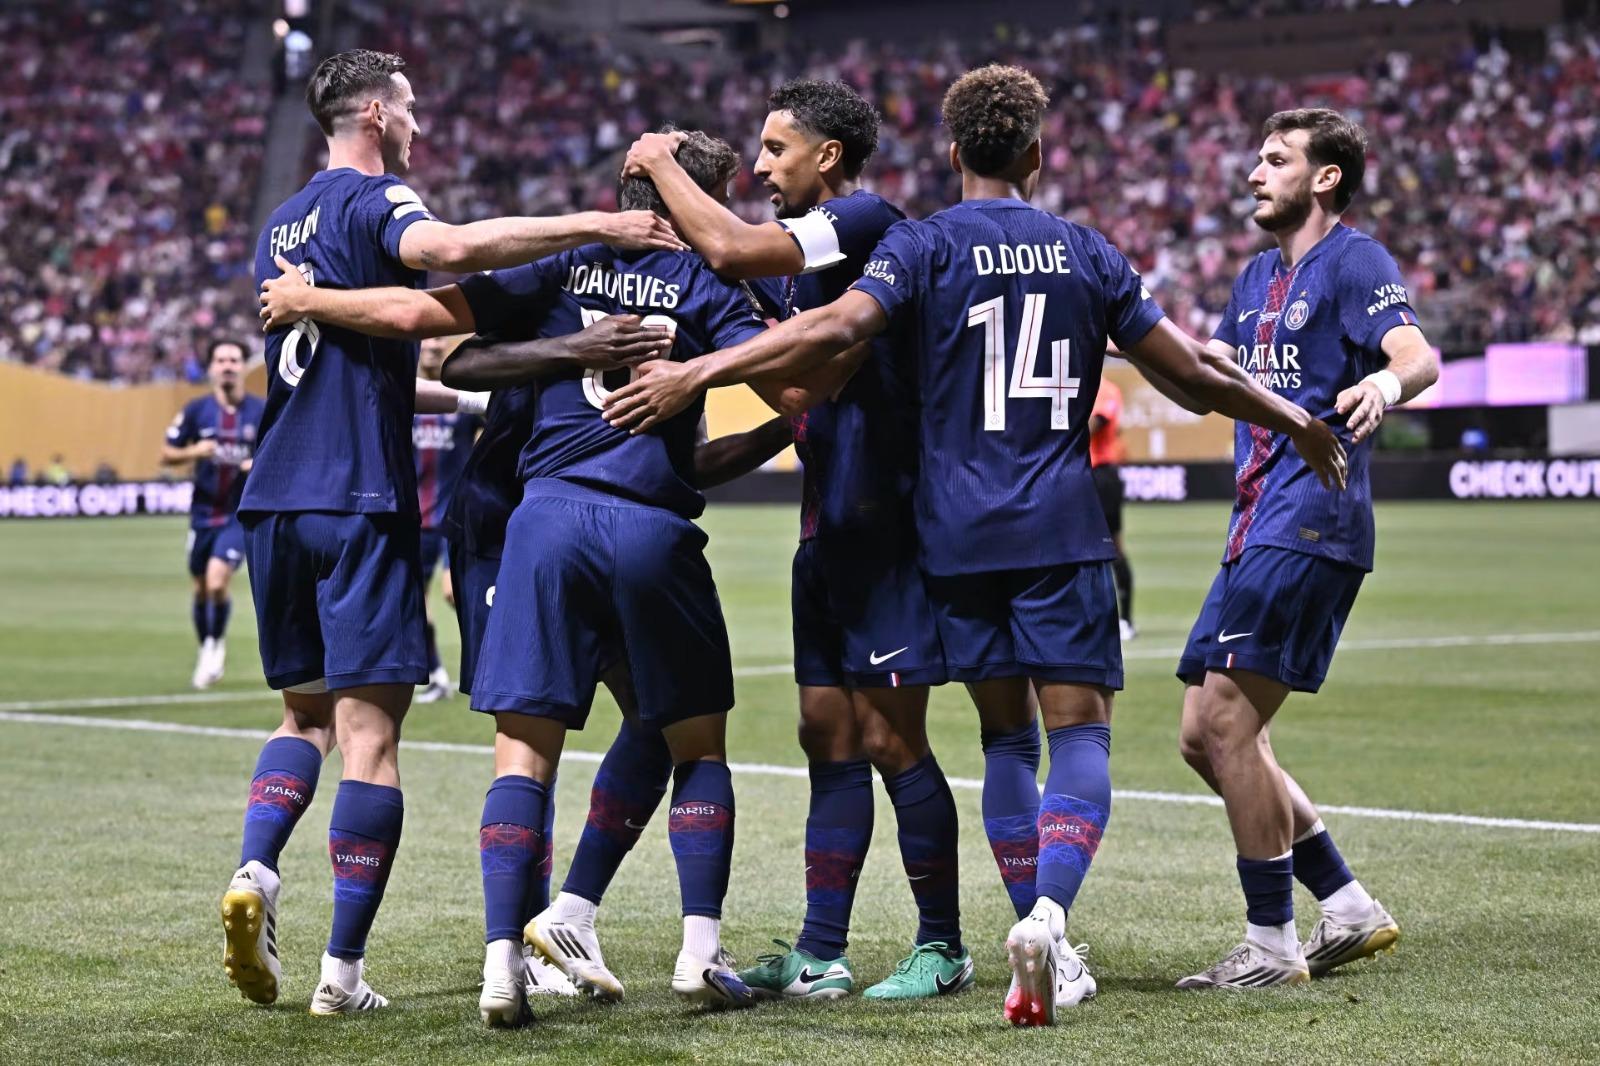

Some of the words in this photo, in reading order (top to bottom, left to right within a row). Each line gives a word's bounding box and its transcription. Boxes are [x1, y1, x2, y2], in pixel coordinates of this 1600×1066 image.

[973, 240, 1071, 276] D.DOUÉ
[967, 293, 1081, 431] 14
[1237, 344, 1302, 370] QATAR
[1450, 460, 1547, 498] CHECK
[79, 483, 140, 515] OUT
[264, 785, 305, 805] PARIS
[670, 805, 715, 816] PARIS
[1041, 823, 1081, 837] PARIS
[336, 854, 380, 867] PARIS
[1003, 856, 1039, 867] PARI
